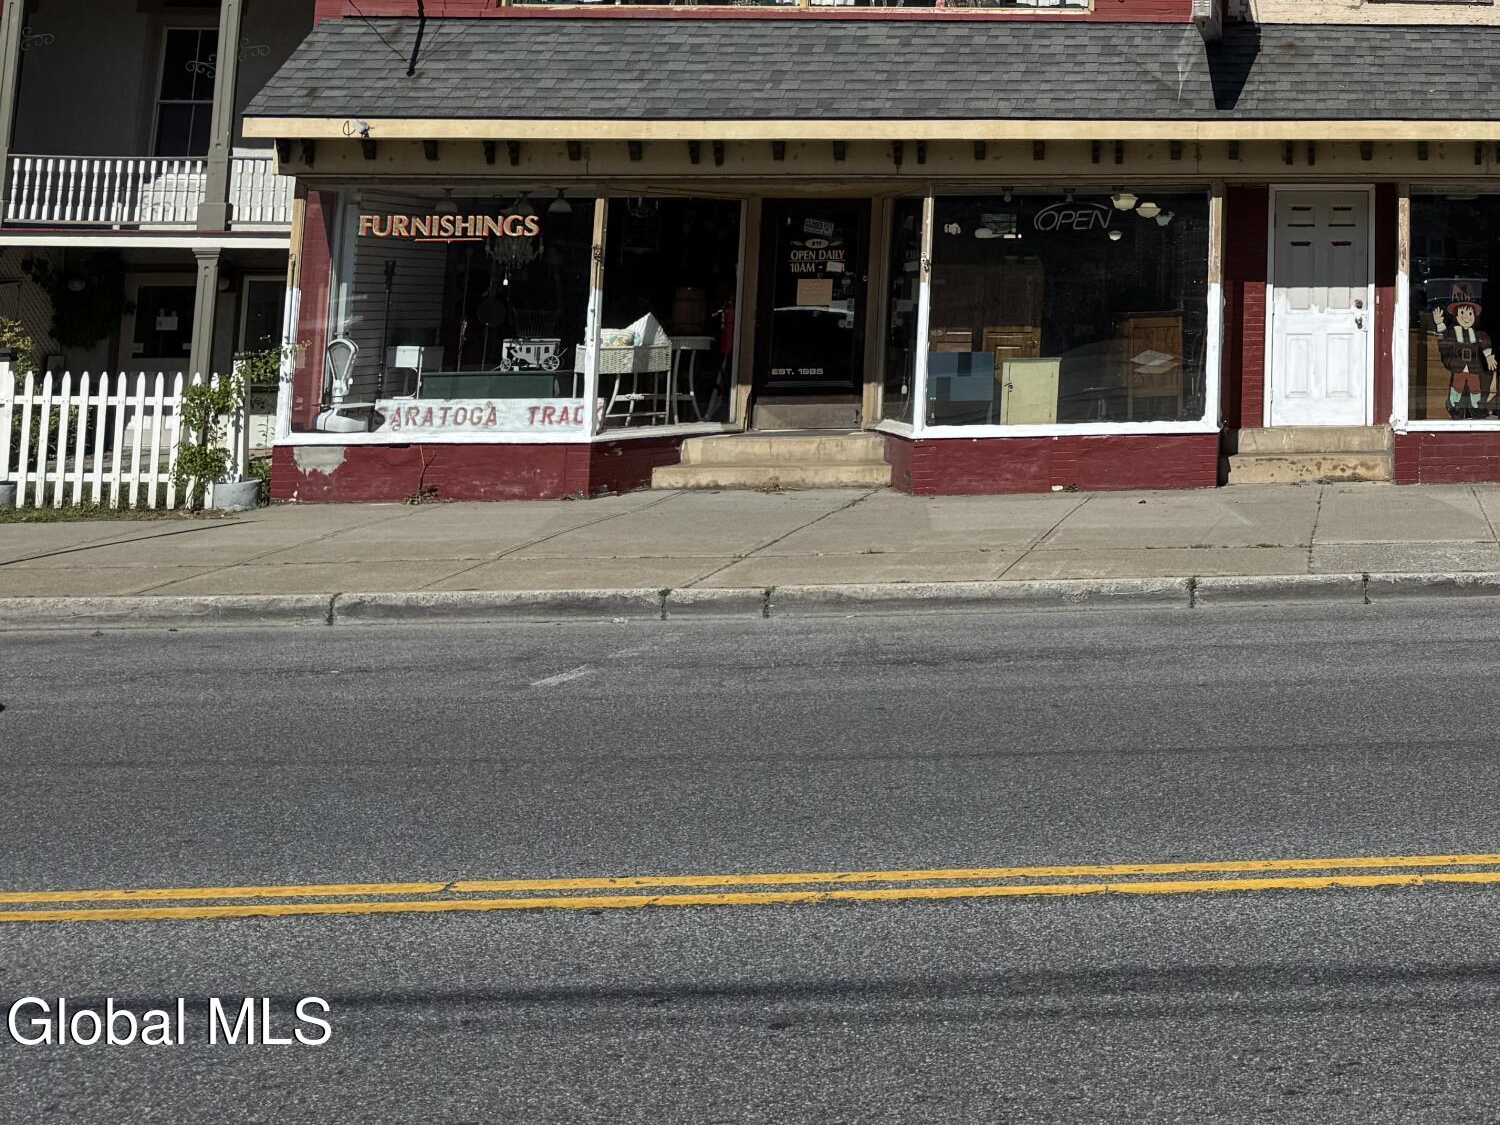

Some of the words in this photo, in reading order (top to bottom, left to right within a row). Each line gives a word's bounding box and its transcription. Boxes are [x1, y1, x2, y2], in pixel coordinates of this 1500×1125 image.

[357, 214, 541, 237] FURNISHINGS
[1037, 209, 1113, 231] OPEN
[790, 249, 816, 260] OPEN
[818, 249, 845, 260] DAILY
[789, 262, 816, 273] 10AM
